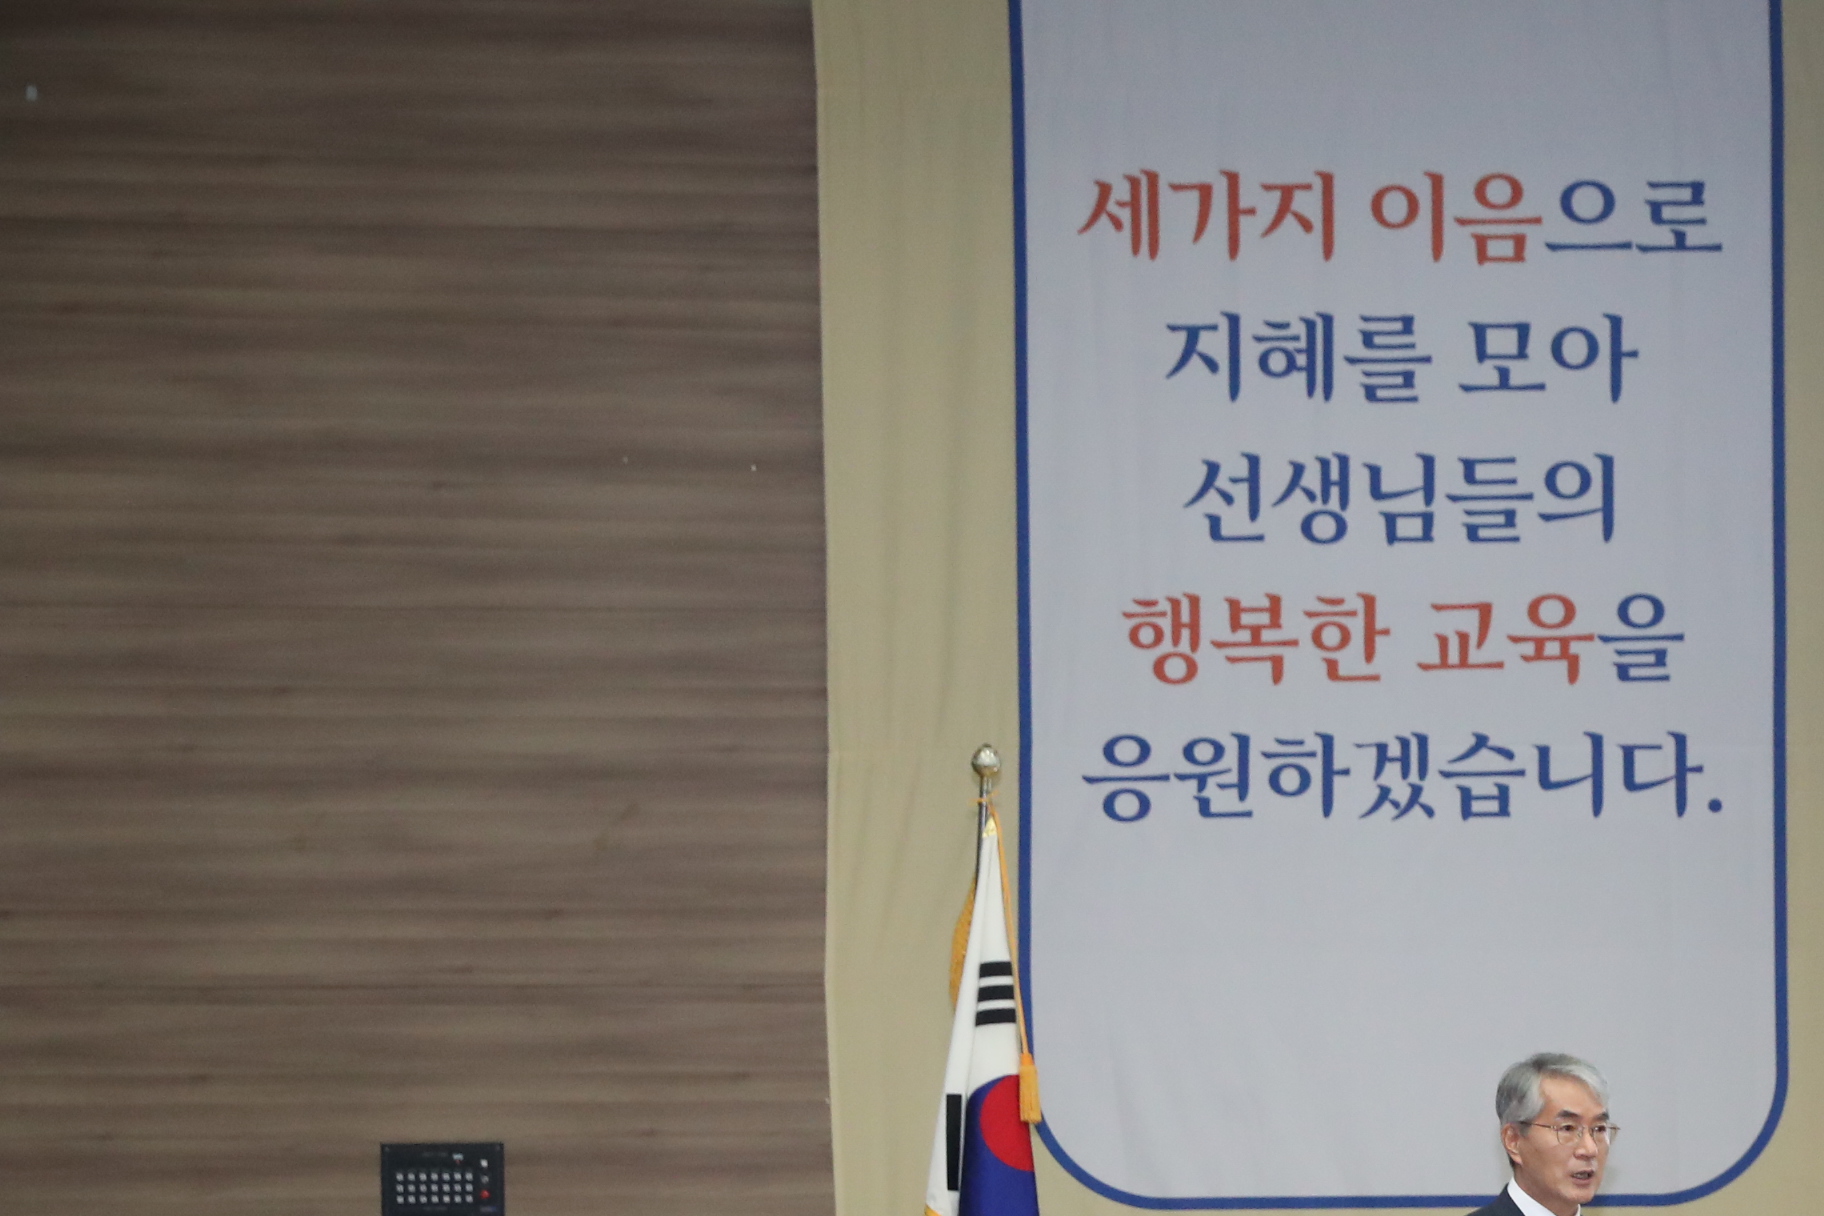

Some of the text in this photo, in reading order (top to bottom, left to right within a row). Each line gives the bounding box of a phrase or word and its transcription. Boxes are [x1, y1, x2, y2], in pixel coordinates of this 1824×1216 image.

[1077, 168, 1723, 266] 세가지 이음으로
[1165, 311, 1640, 405] 지혜를 모아
[1184, 452, 1615, 546] 선생님들의
[1122, 592, 1685, 686] 행복한 교육을
[1082, 732, 1724, 823] 응원하겠습니다.
